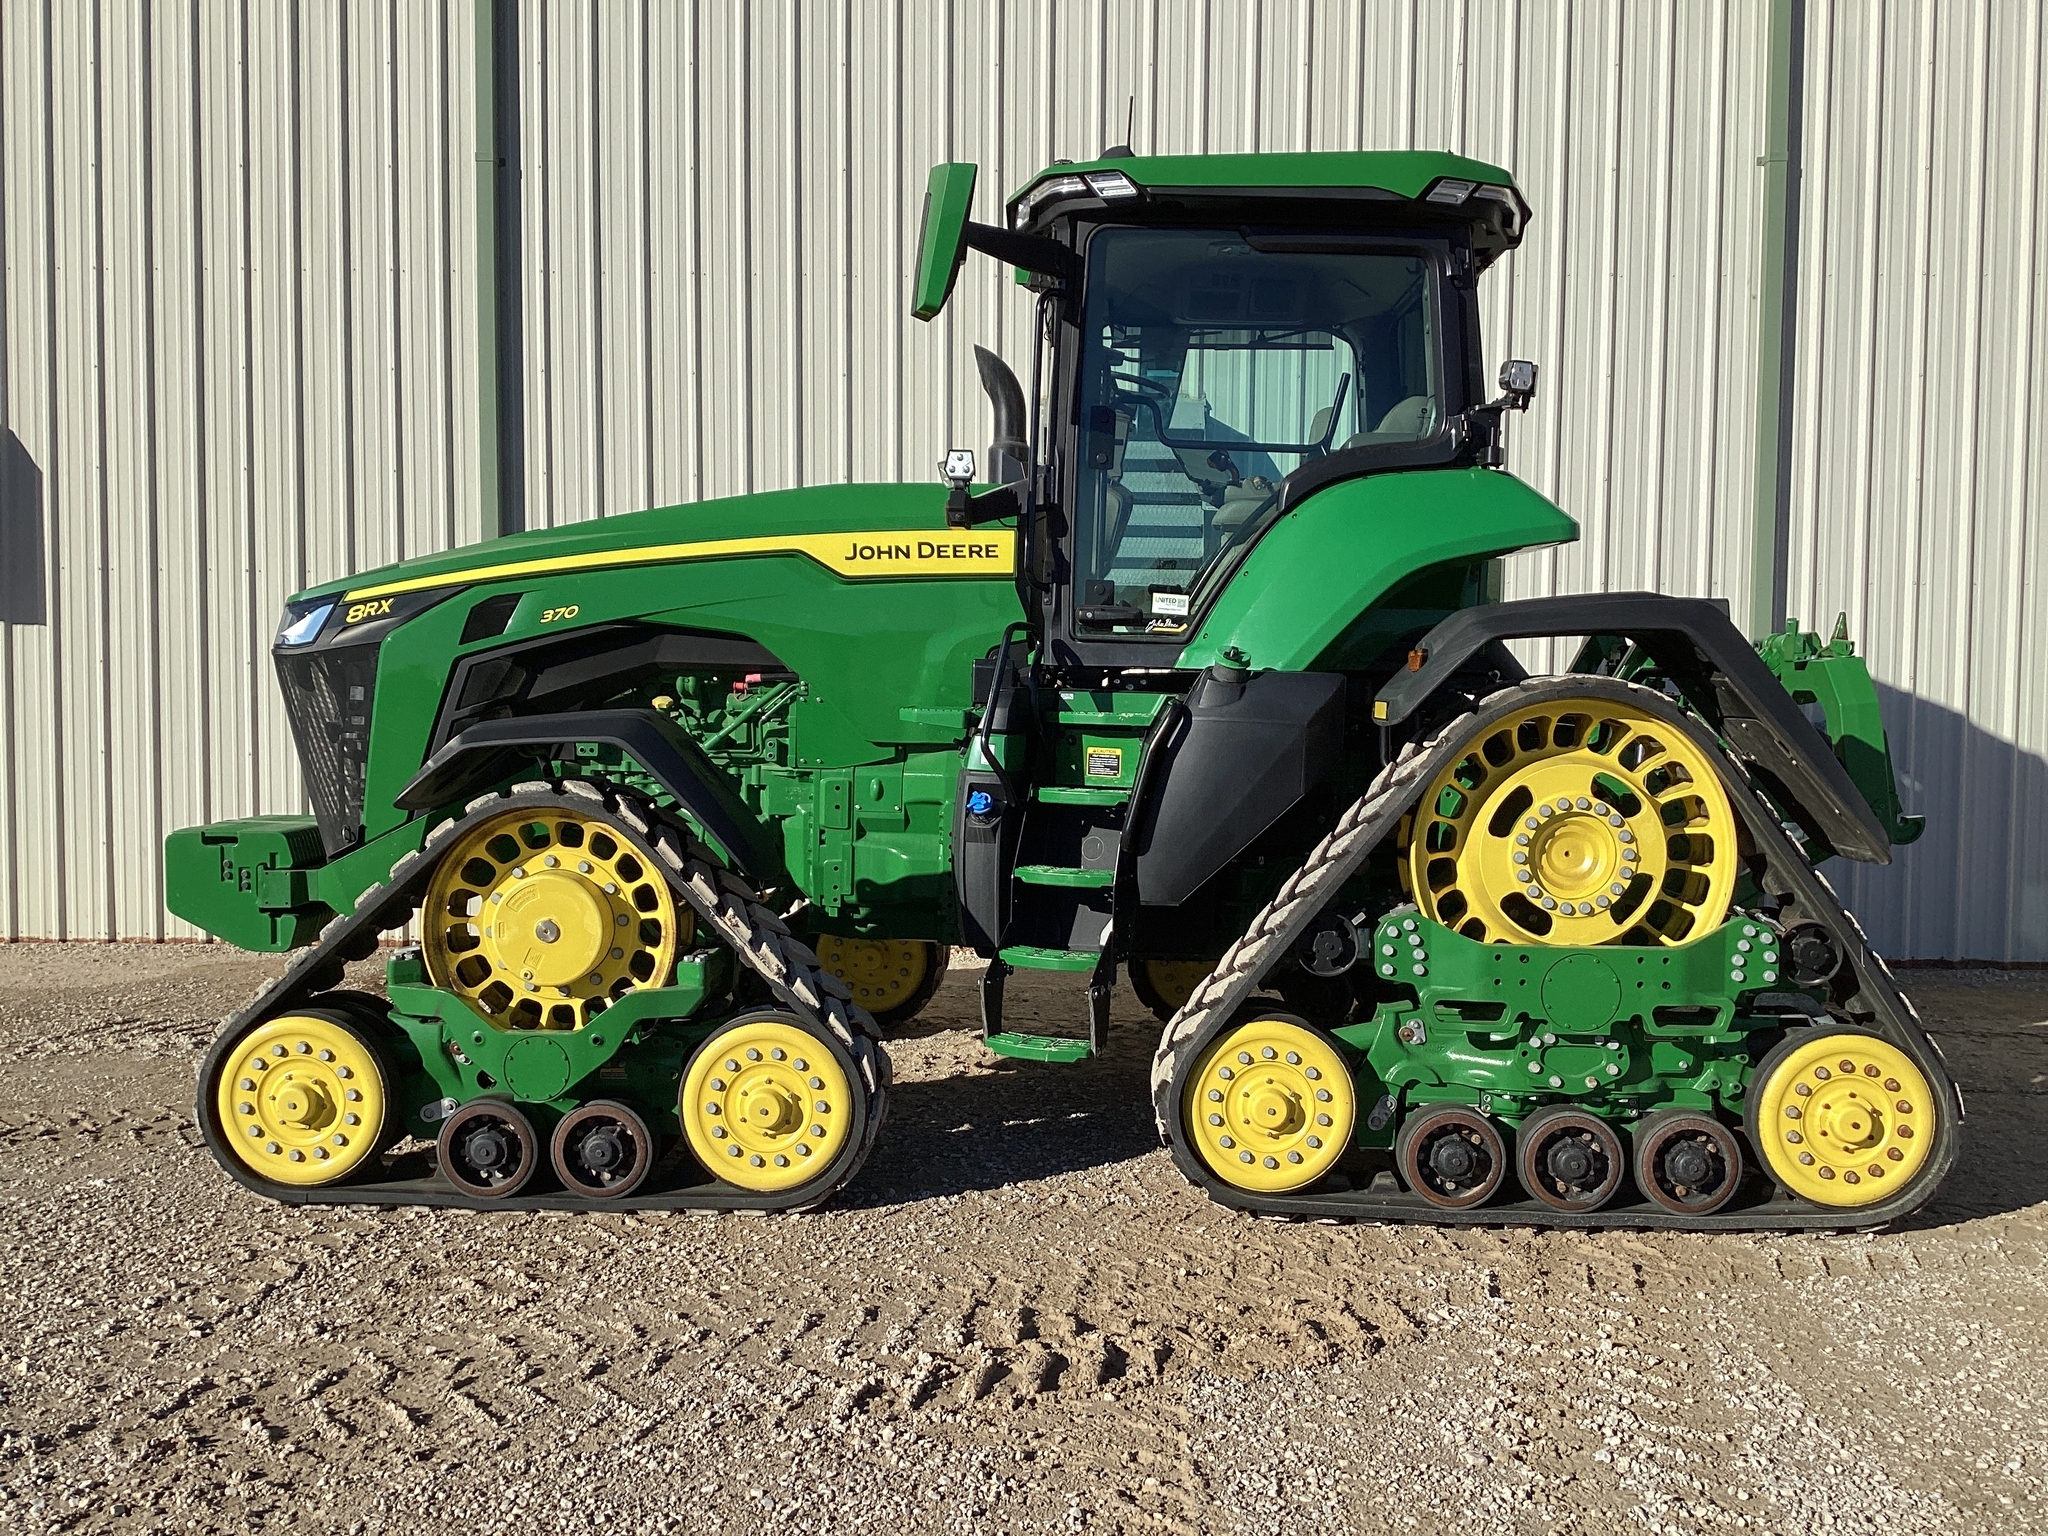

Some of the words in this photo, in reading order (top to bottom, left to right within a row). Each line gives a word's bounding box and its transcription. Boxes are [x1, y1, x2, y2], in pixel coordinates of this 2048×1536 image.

[844, 542, 911, 561] JOHN
[917, 541, 999, 559] DEERE
[1154, 596, 1177, 604] UNITED
[345, 598, 395, 623] 8RX
[540, 605, 580, 623] 370
